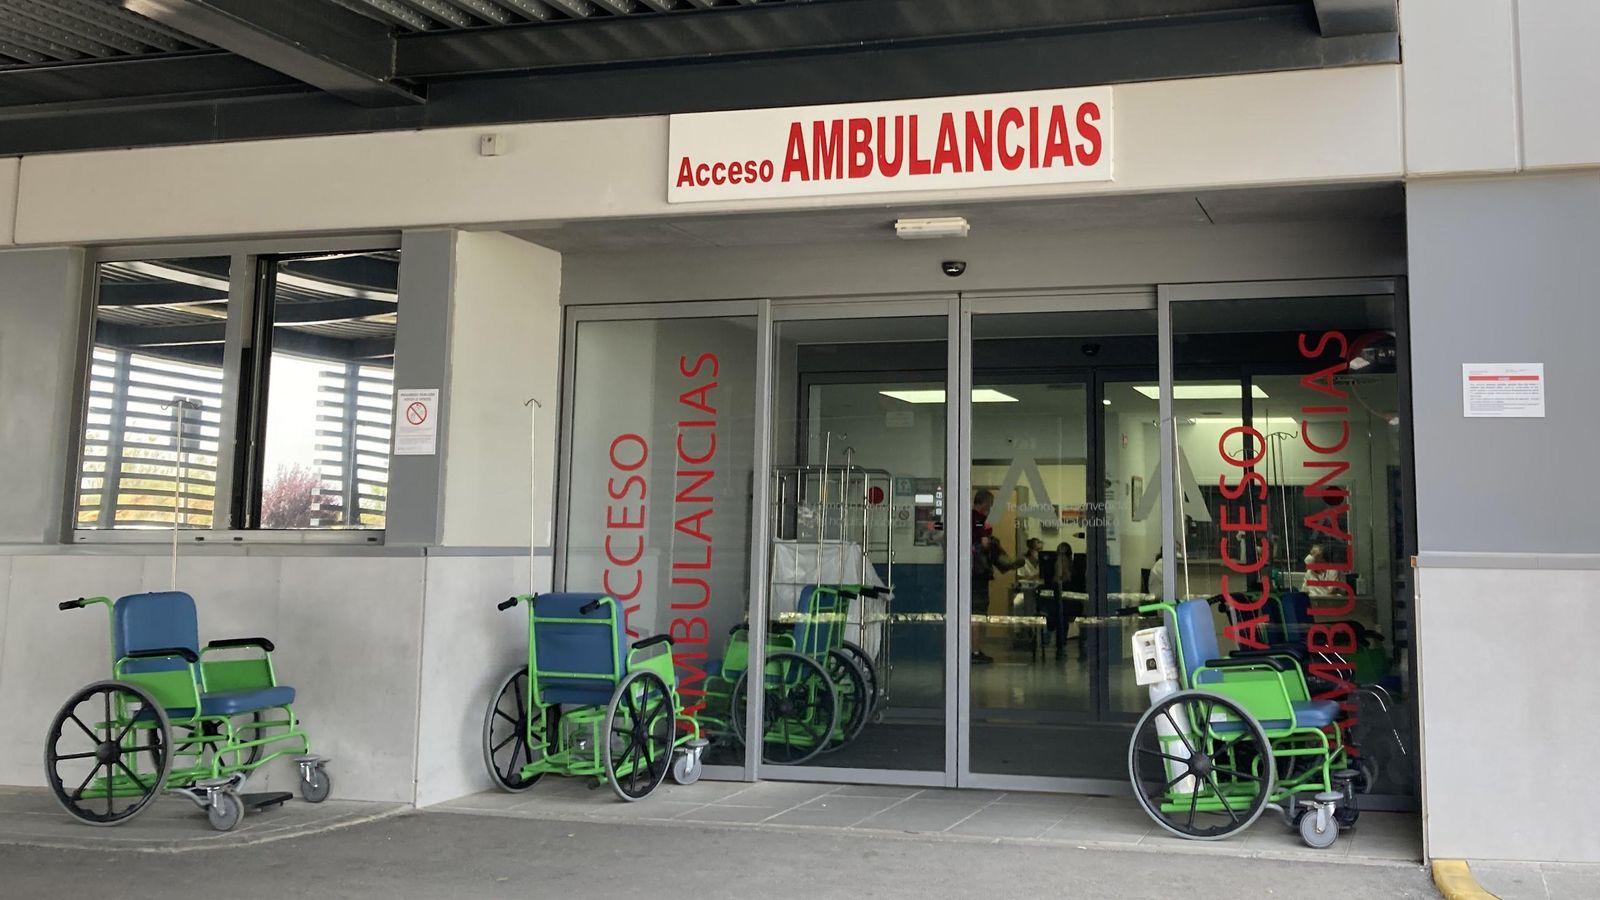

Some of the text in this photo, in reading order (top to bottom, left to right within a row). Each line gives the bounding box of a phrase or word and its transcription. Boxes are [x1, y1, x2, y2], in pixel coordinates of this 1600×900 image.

[676, 101, 1103, 188] Acceso AMBULANCIAS
[1217, 425, 1270, 650] ACCESO
